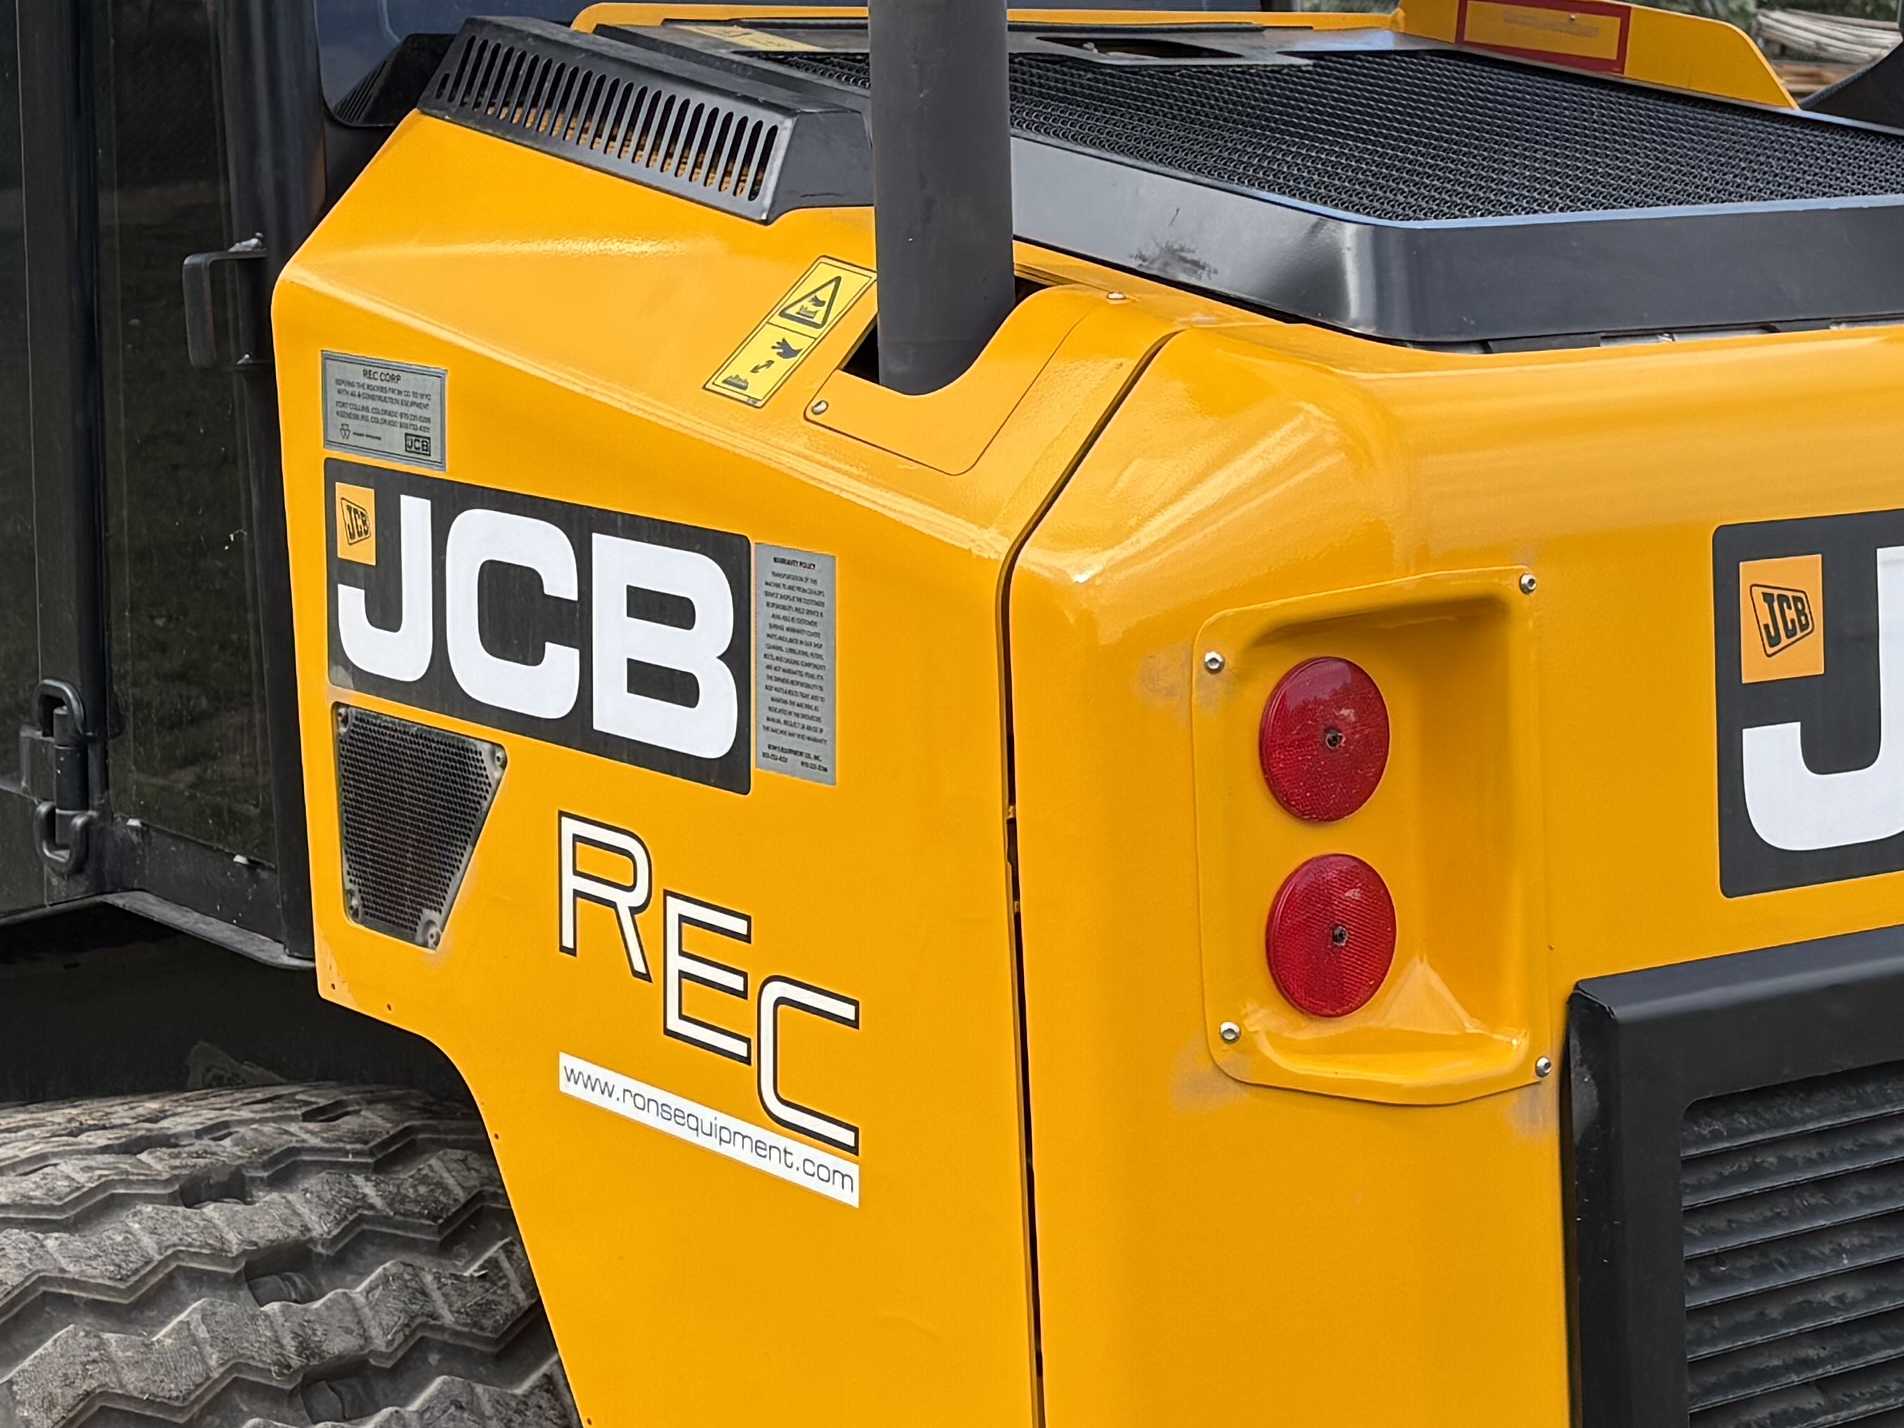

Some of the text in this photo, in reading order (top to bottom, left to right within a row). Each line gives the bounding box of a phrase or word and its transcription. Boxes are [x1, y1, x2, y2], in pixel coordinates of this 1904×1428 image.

[362, 369, 402, 384] REC CORP
[407, 436, 429, 452] JCB
[346, 504, 371, 540] JCB
[337, 493, 739, 759] JCB
[1761, 591, 1810, 648] JCB
[557, 809, 860, 1157] REC
[563, 1064, 855, 1194] www.ronsequipment.com
